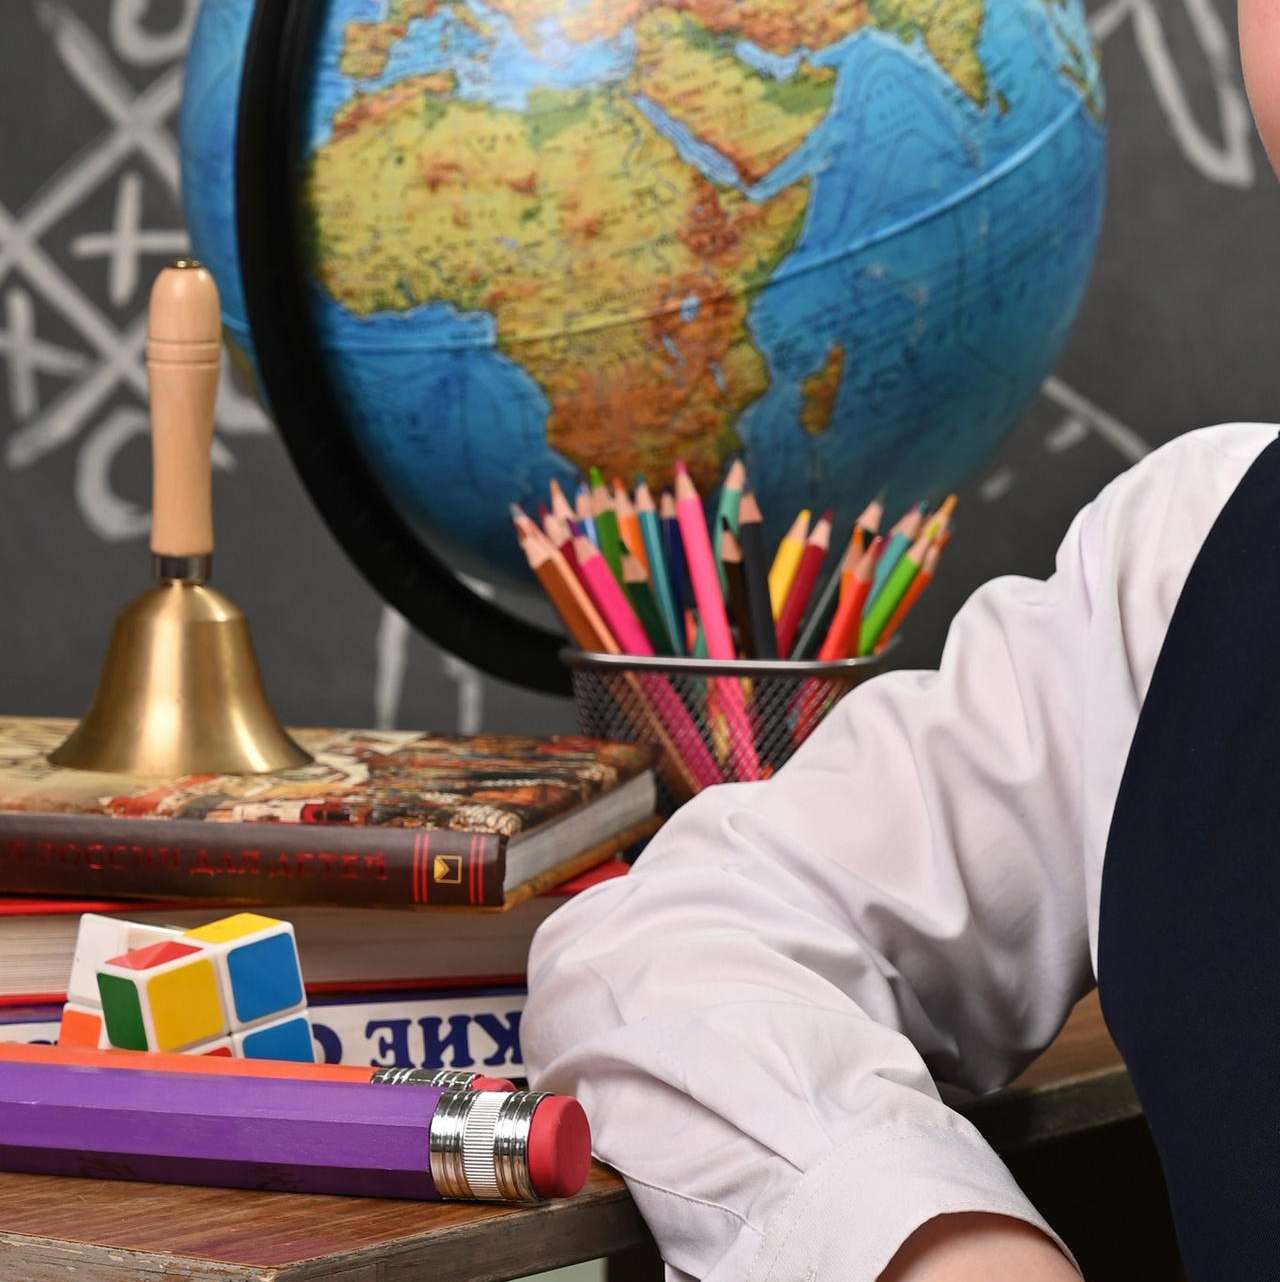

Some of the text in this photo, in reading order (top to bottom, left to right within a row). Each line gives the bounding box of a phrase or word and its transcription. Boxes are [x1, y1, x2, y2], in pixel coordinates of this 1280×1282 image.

[37, 840, 181, 871] РОССИИ
[190, 848, 260, 877] ДЛЯ
[268, 850, 388, 880] ДЕТЕЙ
